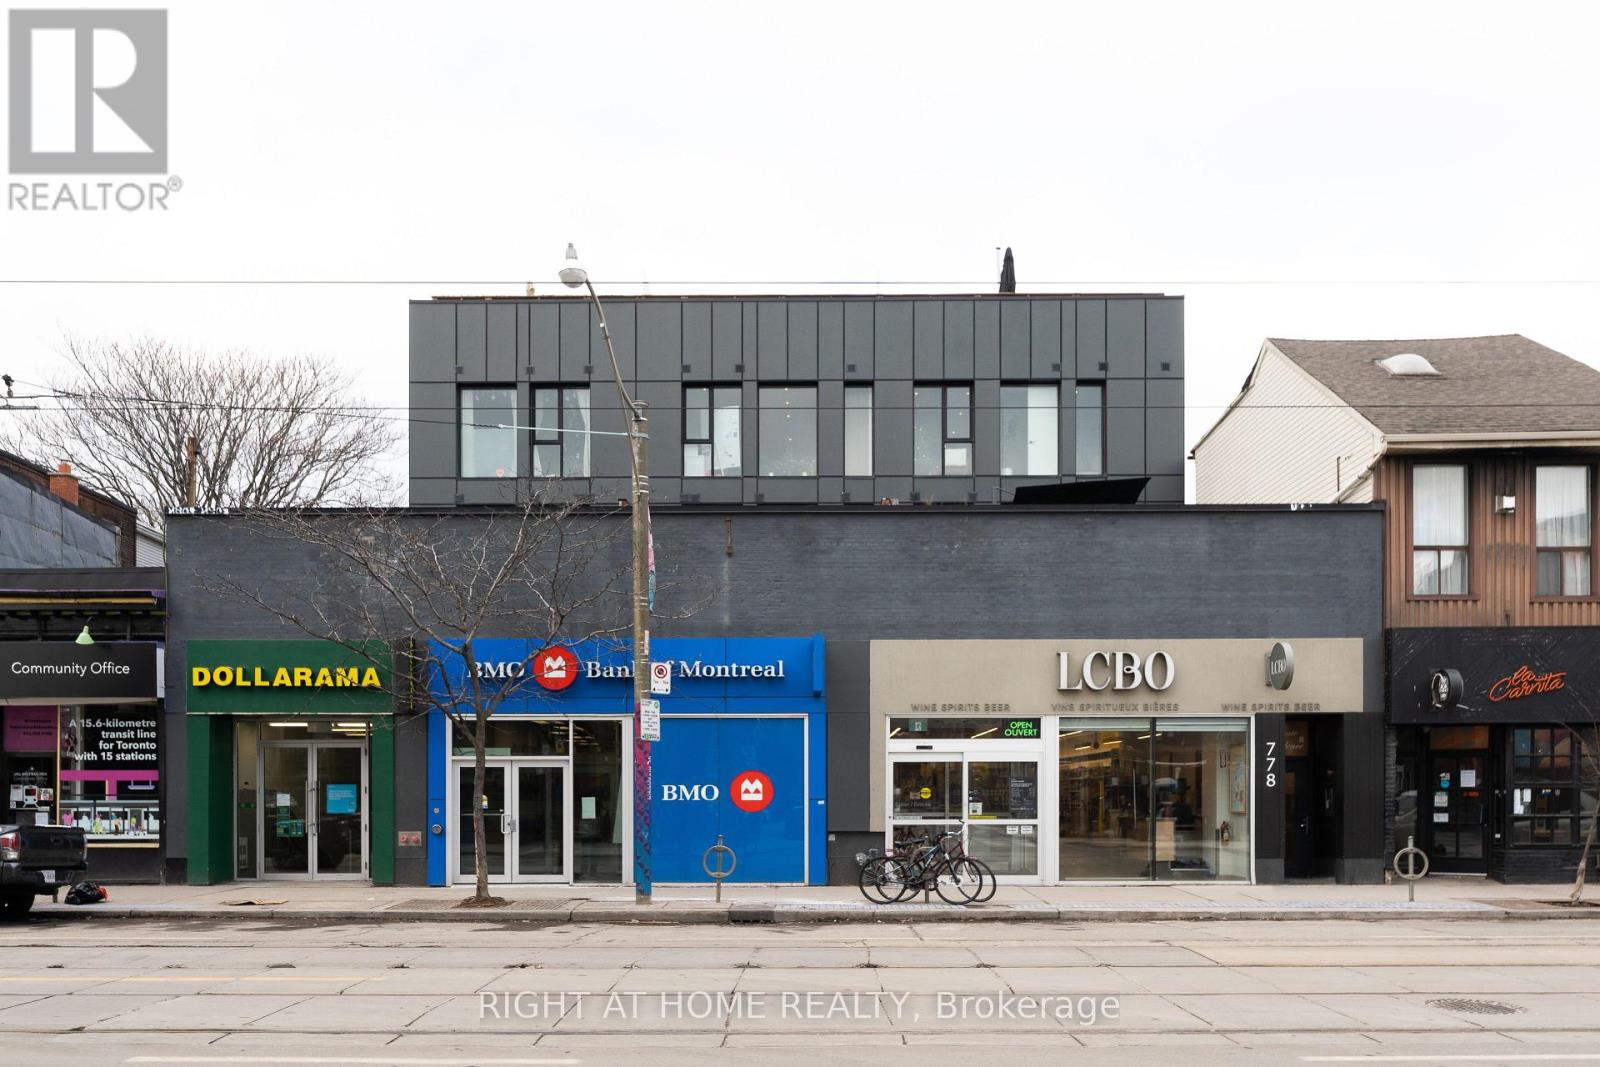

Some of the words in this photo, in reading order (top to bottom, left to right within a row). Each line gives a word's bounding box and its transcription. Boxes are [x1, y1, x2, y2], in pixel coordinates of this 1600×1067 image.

[11, 662, 87, 677] Community
[90, 661, 130, 675] Office
[586, 660, 636, 678] Ban
[679, 660, 785, 678] Montreal
[1056, 651, 1175, 691] LCBO
[192, 666, 382, 687] DOLLARAMA
[911, 703, 937, 712] WINE
[941, 703, 980, 712] SPIRITS
[984, 703, 1011, 712] BEER
[1051, 703, 1075, 712] VINS
[1079, 703, 1139, 712] SPIRITUEUX
[1221, 703, 1247, 712] WINE
[1251, 703, 1290, 712] SPIRITS
[1294, 703, 1321, 712] BEER
[69, 719, 77, 728] A
[80, 719, 157, 728] 15.6-kilometre
[1010, 721, 1033, 729] OPEN
[101, 729, 134, 739] transit
[137, 729, 157, 739] line
[1004, 729, 1037, 737] OUVERT
[99, 740, 114, 750] for
[116, 741, 157, 750] Toronto
[74, 751, 97, 761] with
[100, 752, 113, 761] 15
[115, 751, 157, 761] stations
[662, 784, 719, 801] BMO
